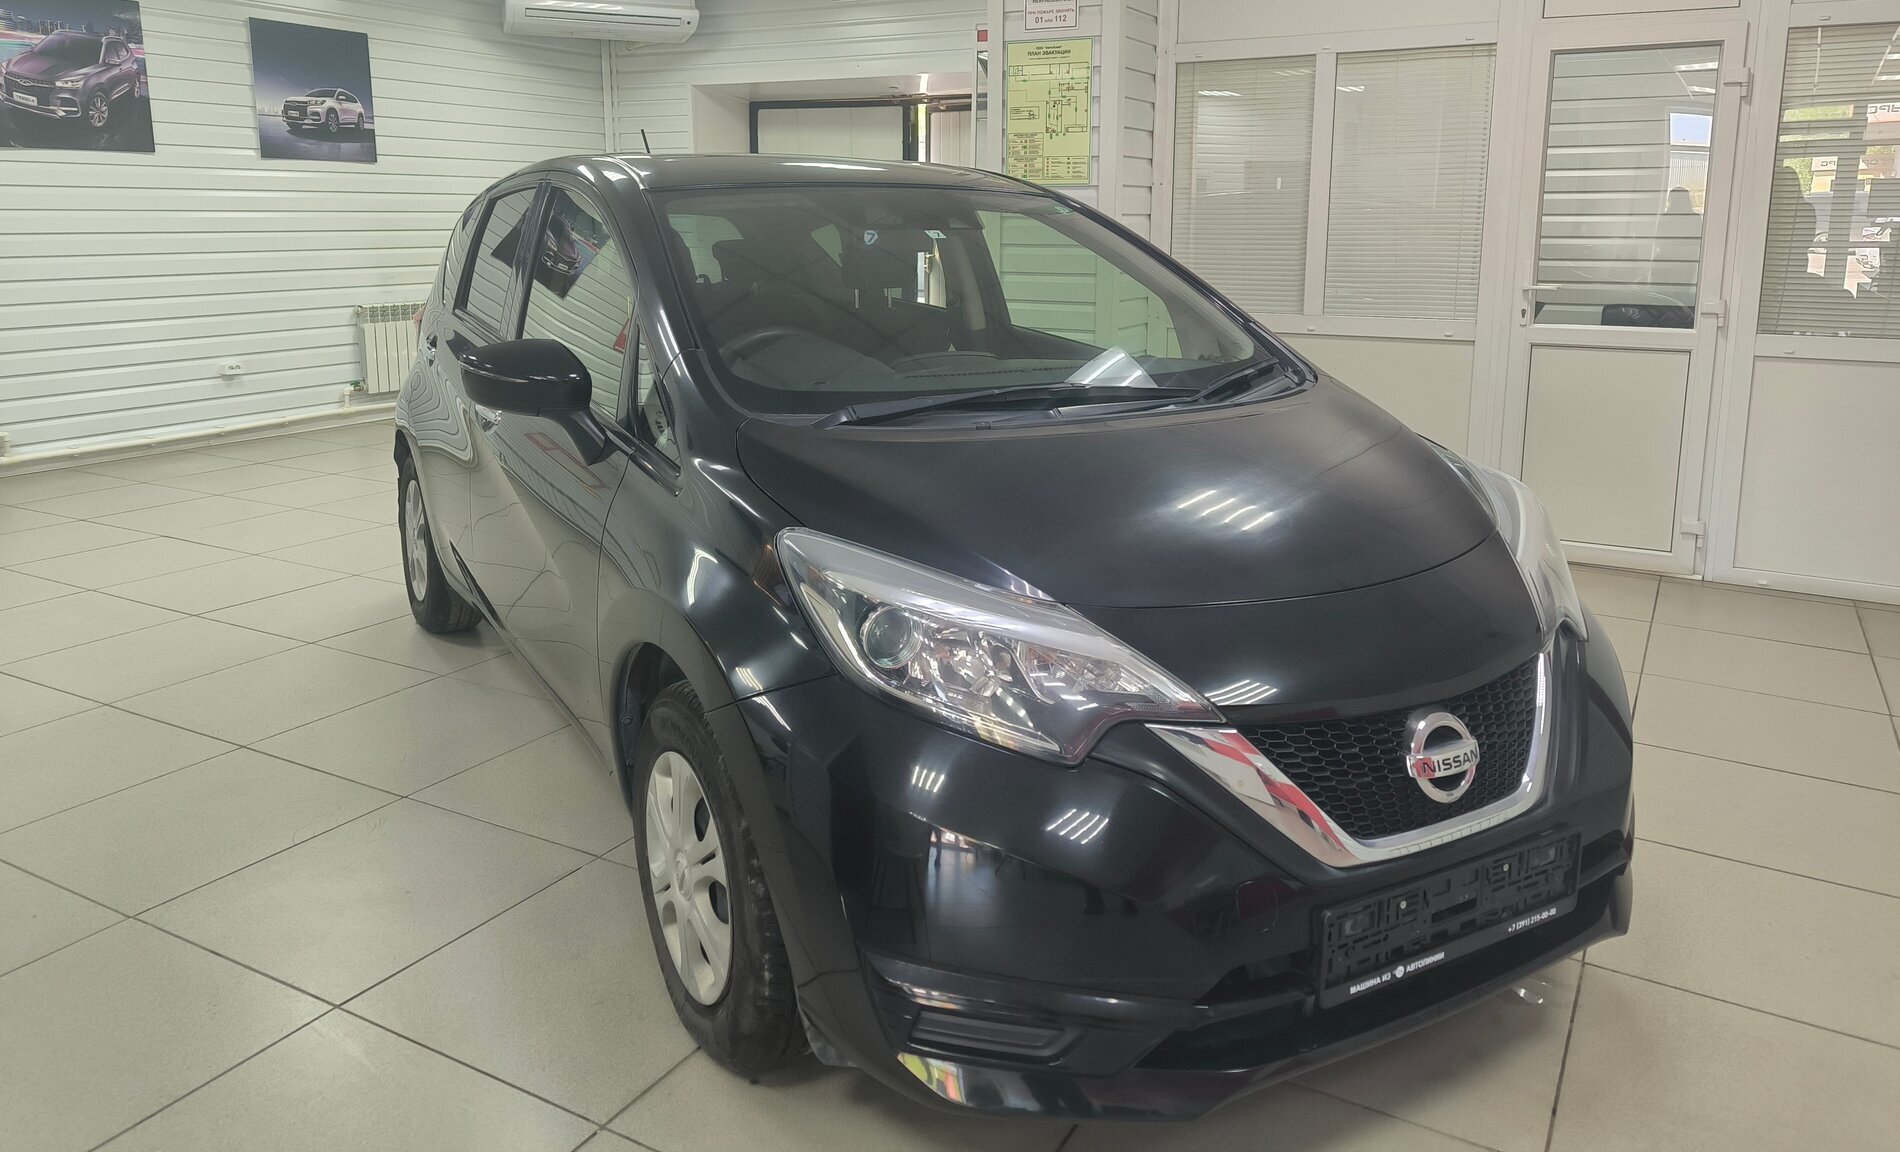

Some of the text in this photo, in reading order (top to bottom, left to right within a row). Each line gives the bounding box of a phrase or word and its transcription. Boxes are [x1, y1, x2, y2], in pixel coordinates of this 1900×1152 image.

[1055, 14, 1067, 22] 112
[1422, 749, 1478, 774] NISSAN
[1349, 976, 1382, 995] МАШИНА
[1381, 972, 1391, 983] ИЗ
